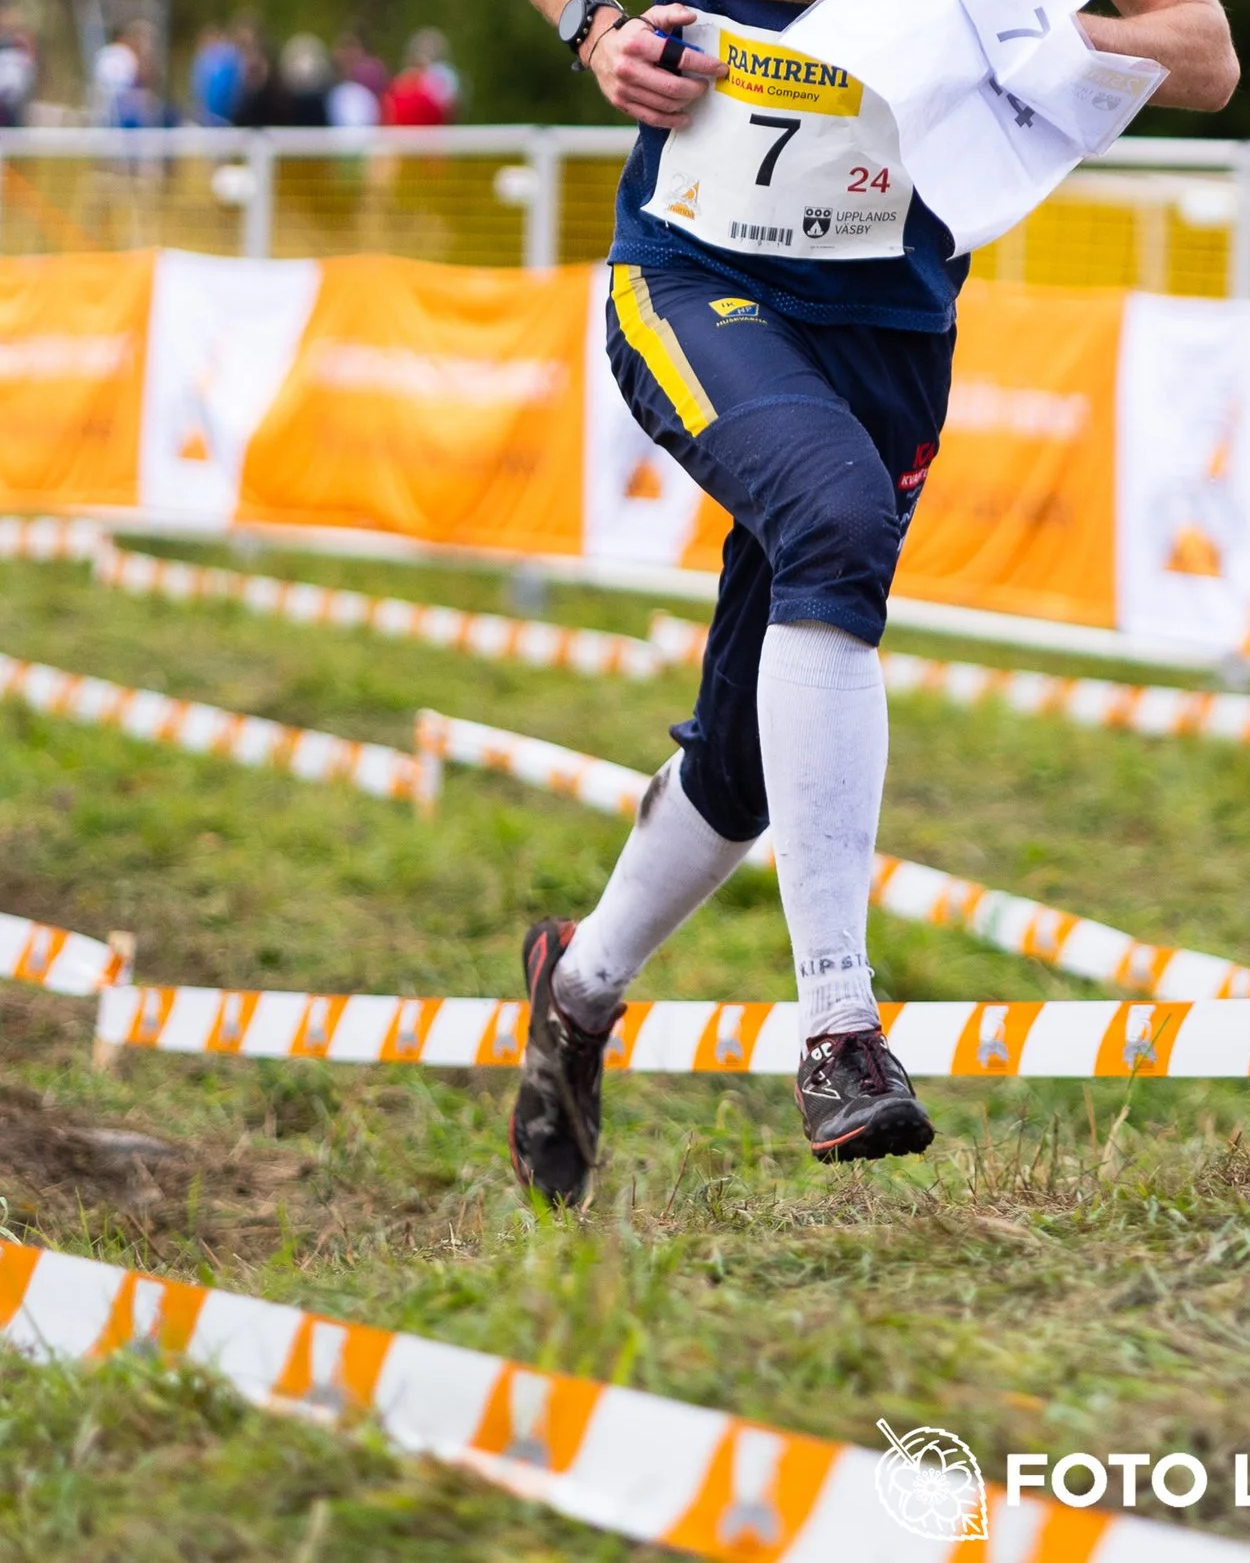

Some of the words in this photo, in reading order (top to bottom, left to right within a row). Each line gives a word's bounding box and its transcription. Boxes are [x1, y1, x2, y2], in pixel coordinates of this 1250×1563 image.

[731, 78, 764, 93] LOXAM
[767, 86, 820, 103] Company
[749, 113, 802, 187] 7
[847, 166, 891, 194] 24
[834, 223, 873, 236] VÄSBY
[836, 211, 897, 223] UPPLANDS
[799, 952, 870, 978] KIPST
